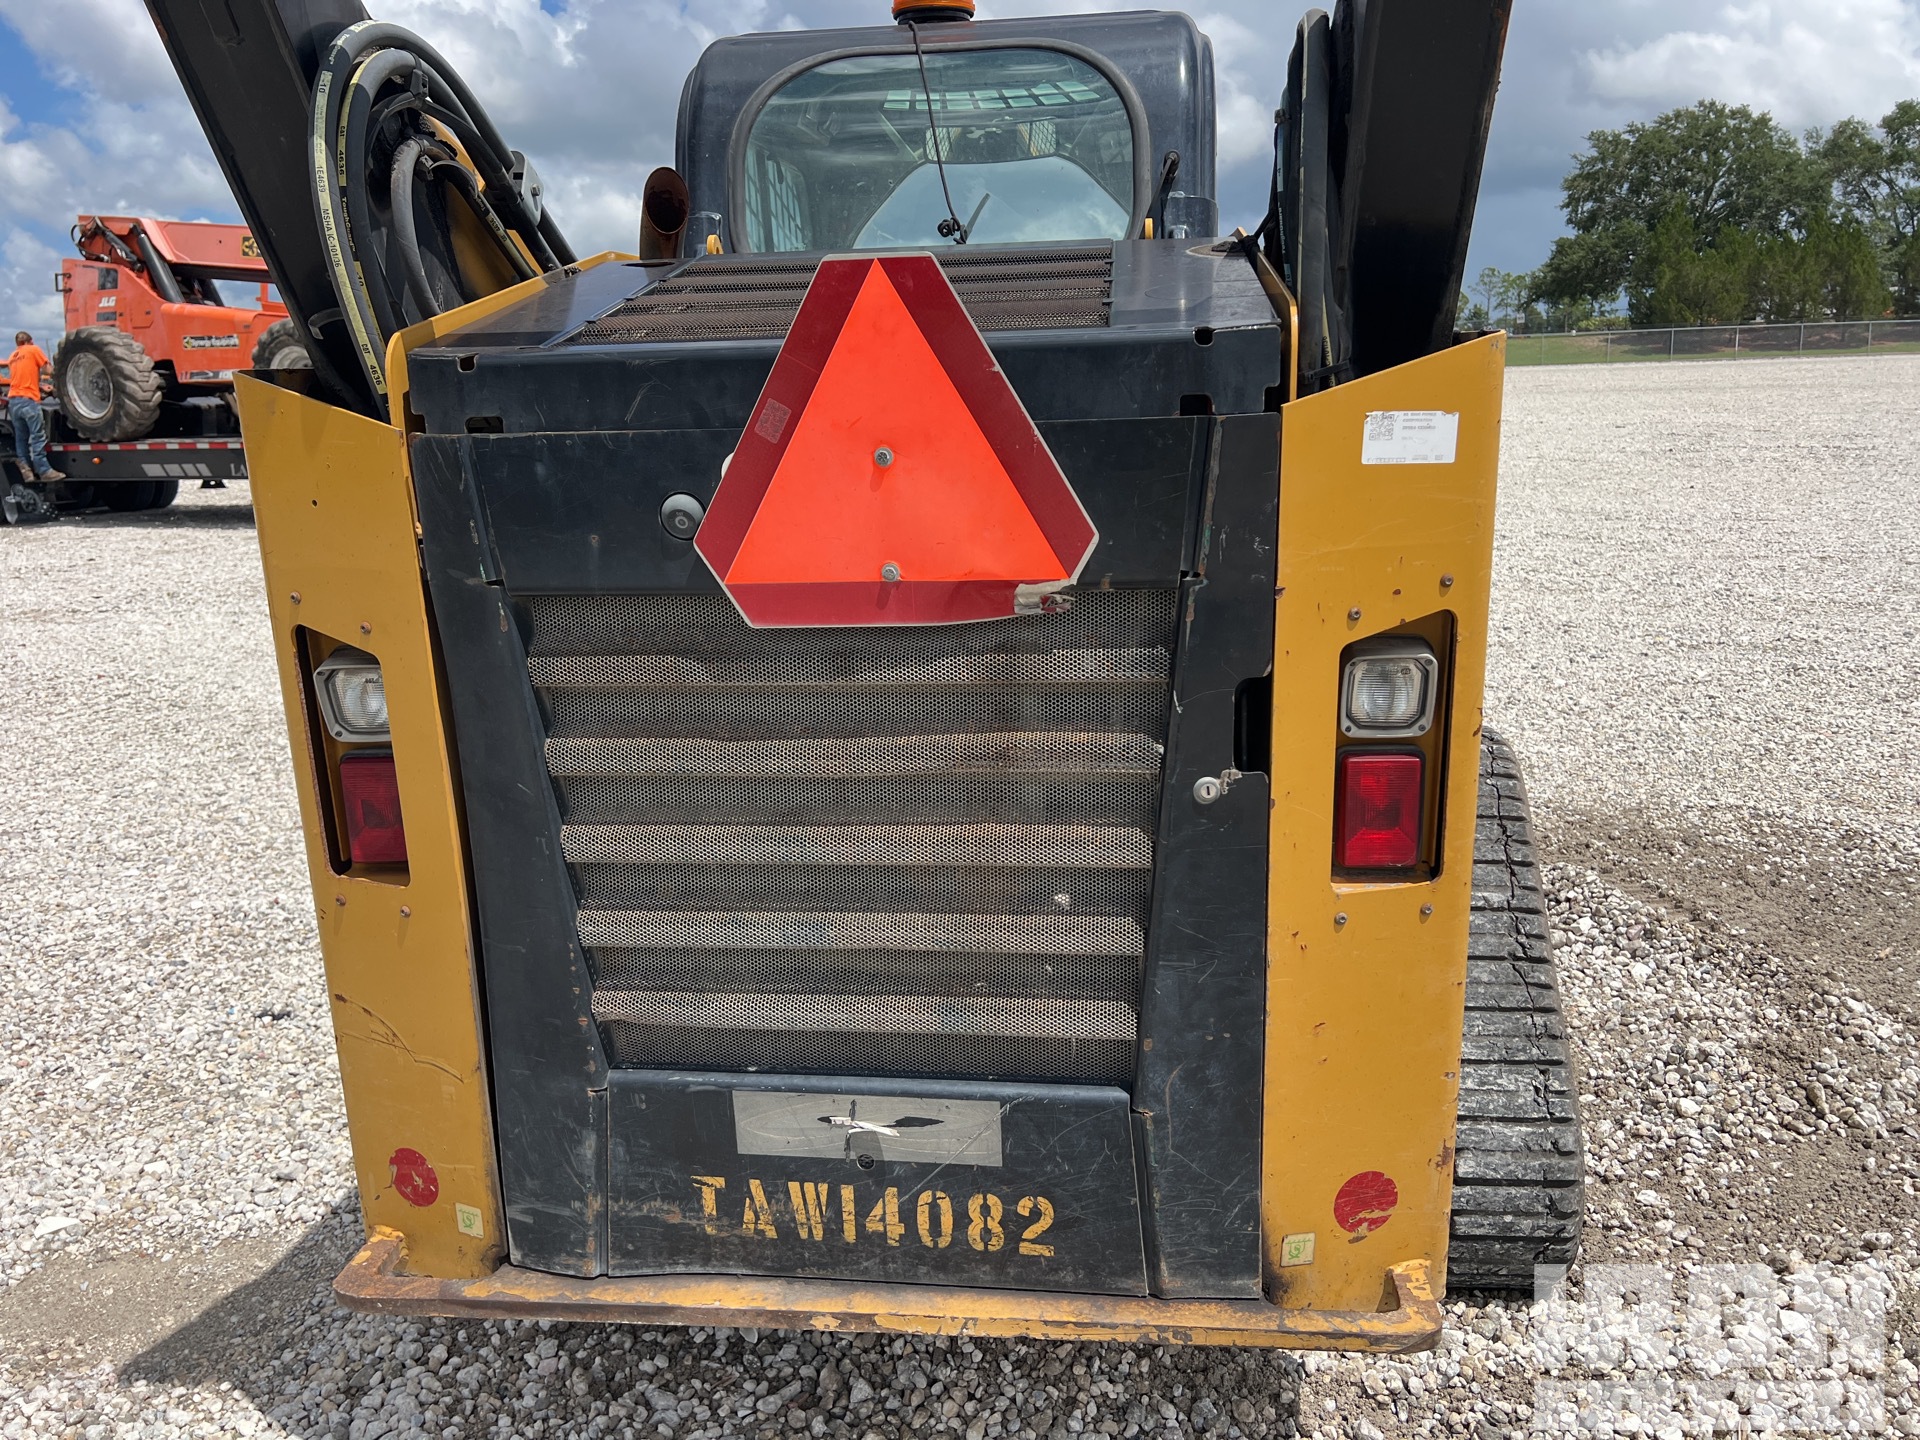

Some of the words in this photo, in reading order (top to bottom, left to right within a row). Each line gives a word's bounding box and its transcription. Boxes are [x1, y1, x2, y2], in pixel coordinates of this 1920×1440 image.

[322, 208, 333, 232] MSHA
[99, 296, 117, 307] JLG
[369, 364, 383, 386] 4636
